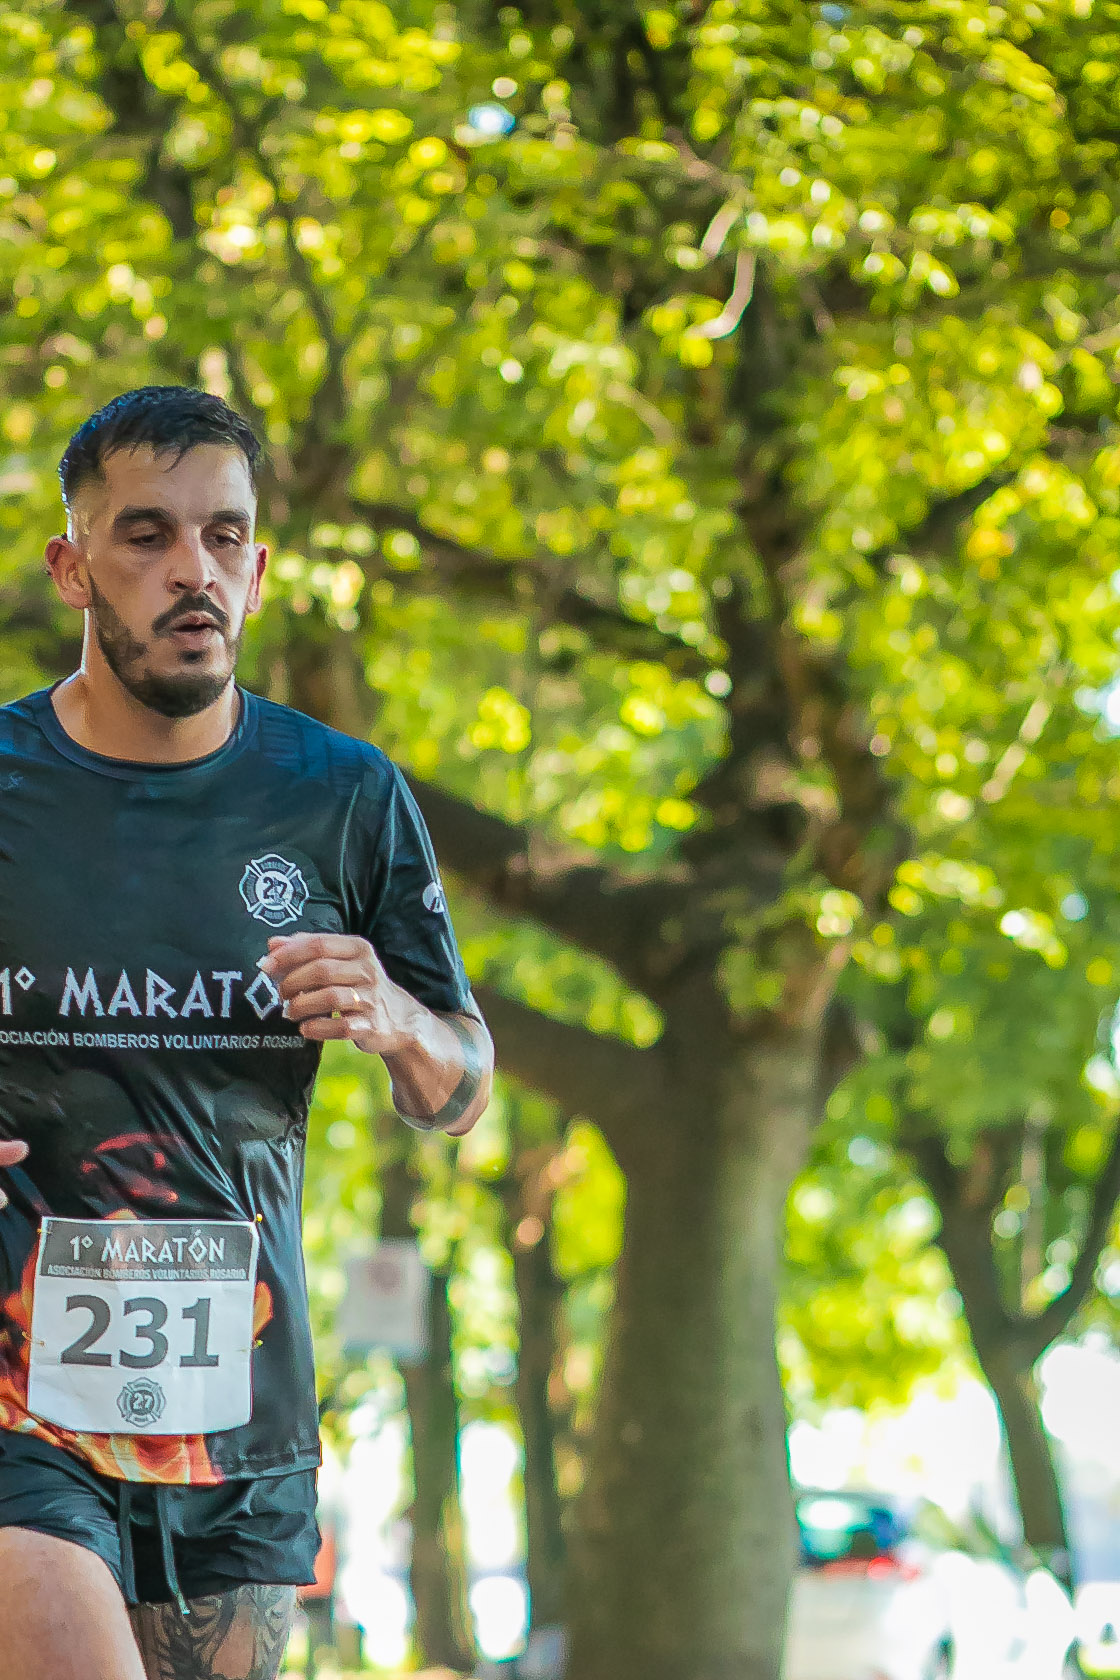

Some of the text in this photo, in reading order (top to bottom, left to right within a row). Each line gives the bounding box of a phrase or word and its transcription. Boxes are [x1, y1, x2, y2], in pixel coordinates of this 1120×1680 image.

[263, 876, 288, 900] 27
[58, 966, 279, 1021] MARATO
[73, 1032, 160, 1049] BOMBEROS
[163, 1034, 260, 1049] VOLUNTARIOS
[101, 1228, 225, 1263] MARATÓN
[60, 1294, 220, 1370] 231
[132, 1392, 153, 1410] 27
